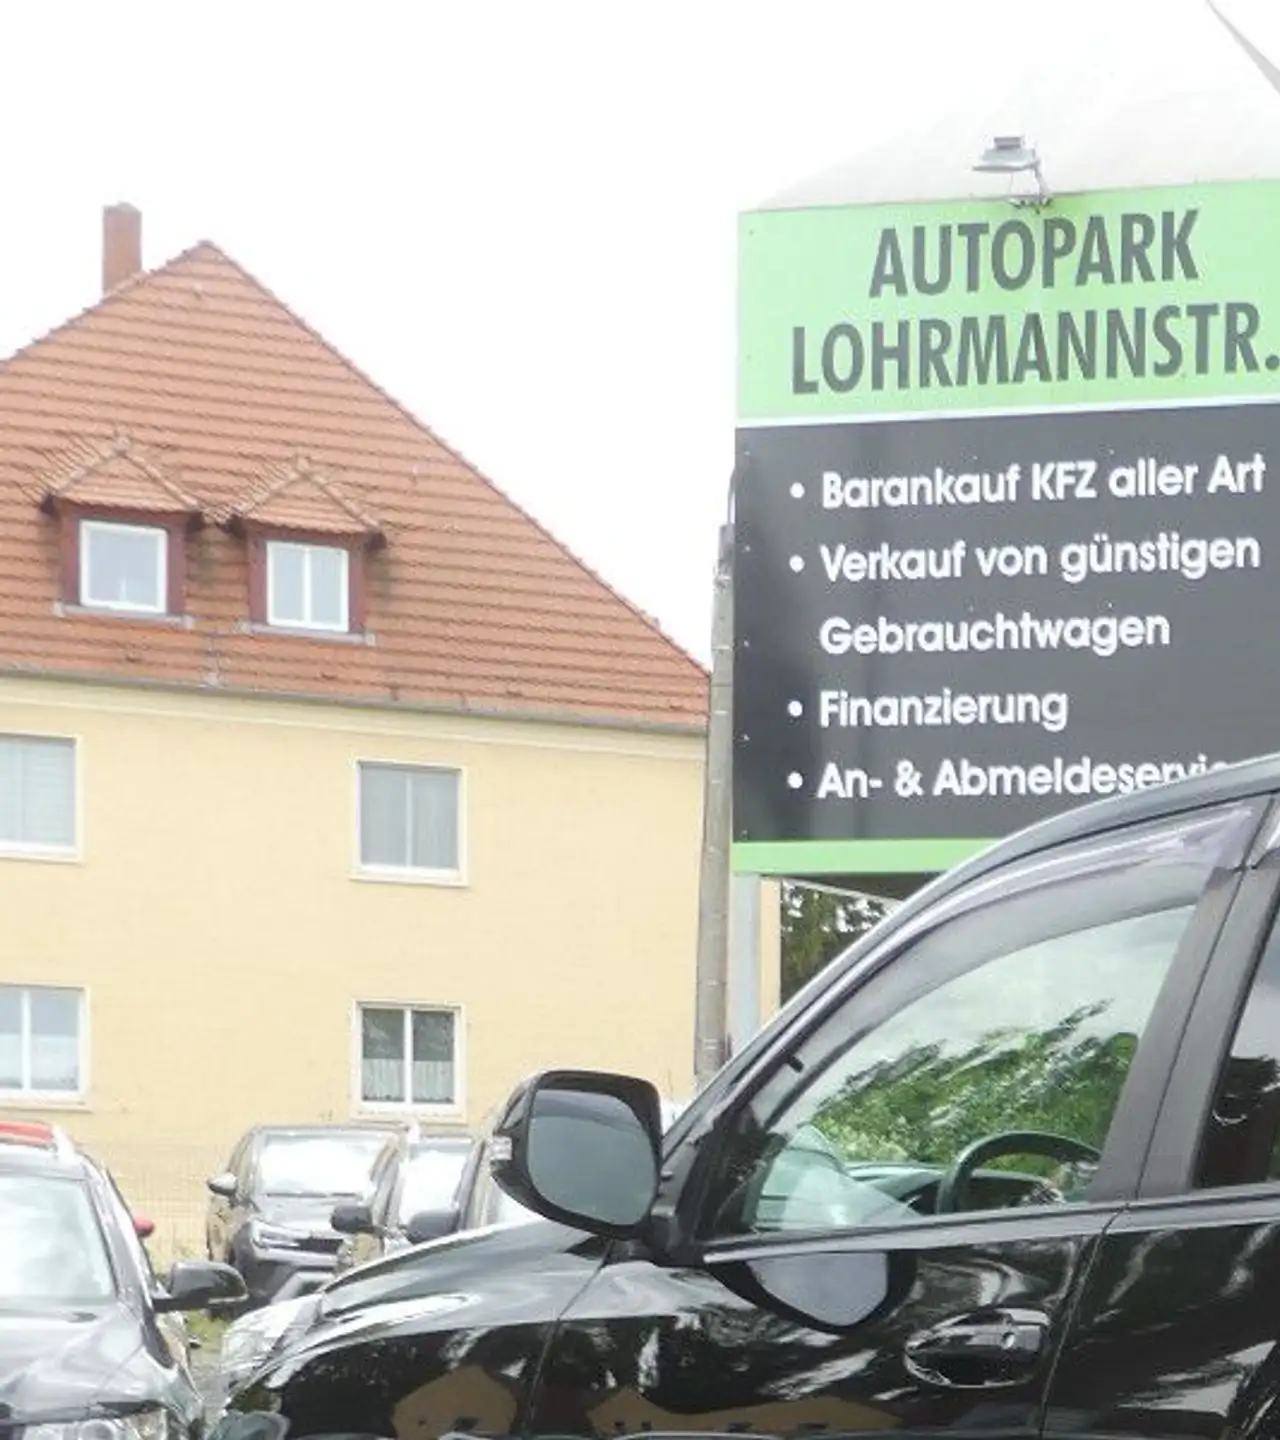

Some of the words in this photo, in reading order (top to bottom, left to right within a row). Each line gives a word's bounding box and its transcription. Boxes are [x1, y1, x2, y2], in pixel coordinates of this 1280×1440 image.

[869, 209, 1198, 298] AUTOPARK
[793, 302, 1280, 394] LOHRMANNSTR.
[822, 465, 1020, 508] Barankauf
[1032, 461, 1098, 499] KFZ
[1109, 458, 1199, 498] aller
[1208, 454, 1266, 493] Art
[820, 540, 966, 582] Verkauf
[975, 545, 1048, 577] von
[1061, 532, 1261, 583] günstigen
[819, 613, 1170, 655] Gebrauchtwagen
[819, 688, 1068, 731] Finanzierung
[817, 762, 883, 798] An-
[895, 760, 922, 797] &
[933, 754, 1230, 796] Abmeldeservi
